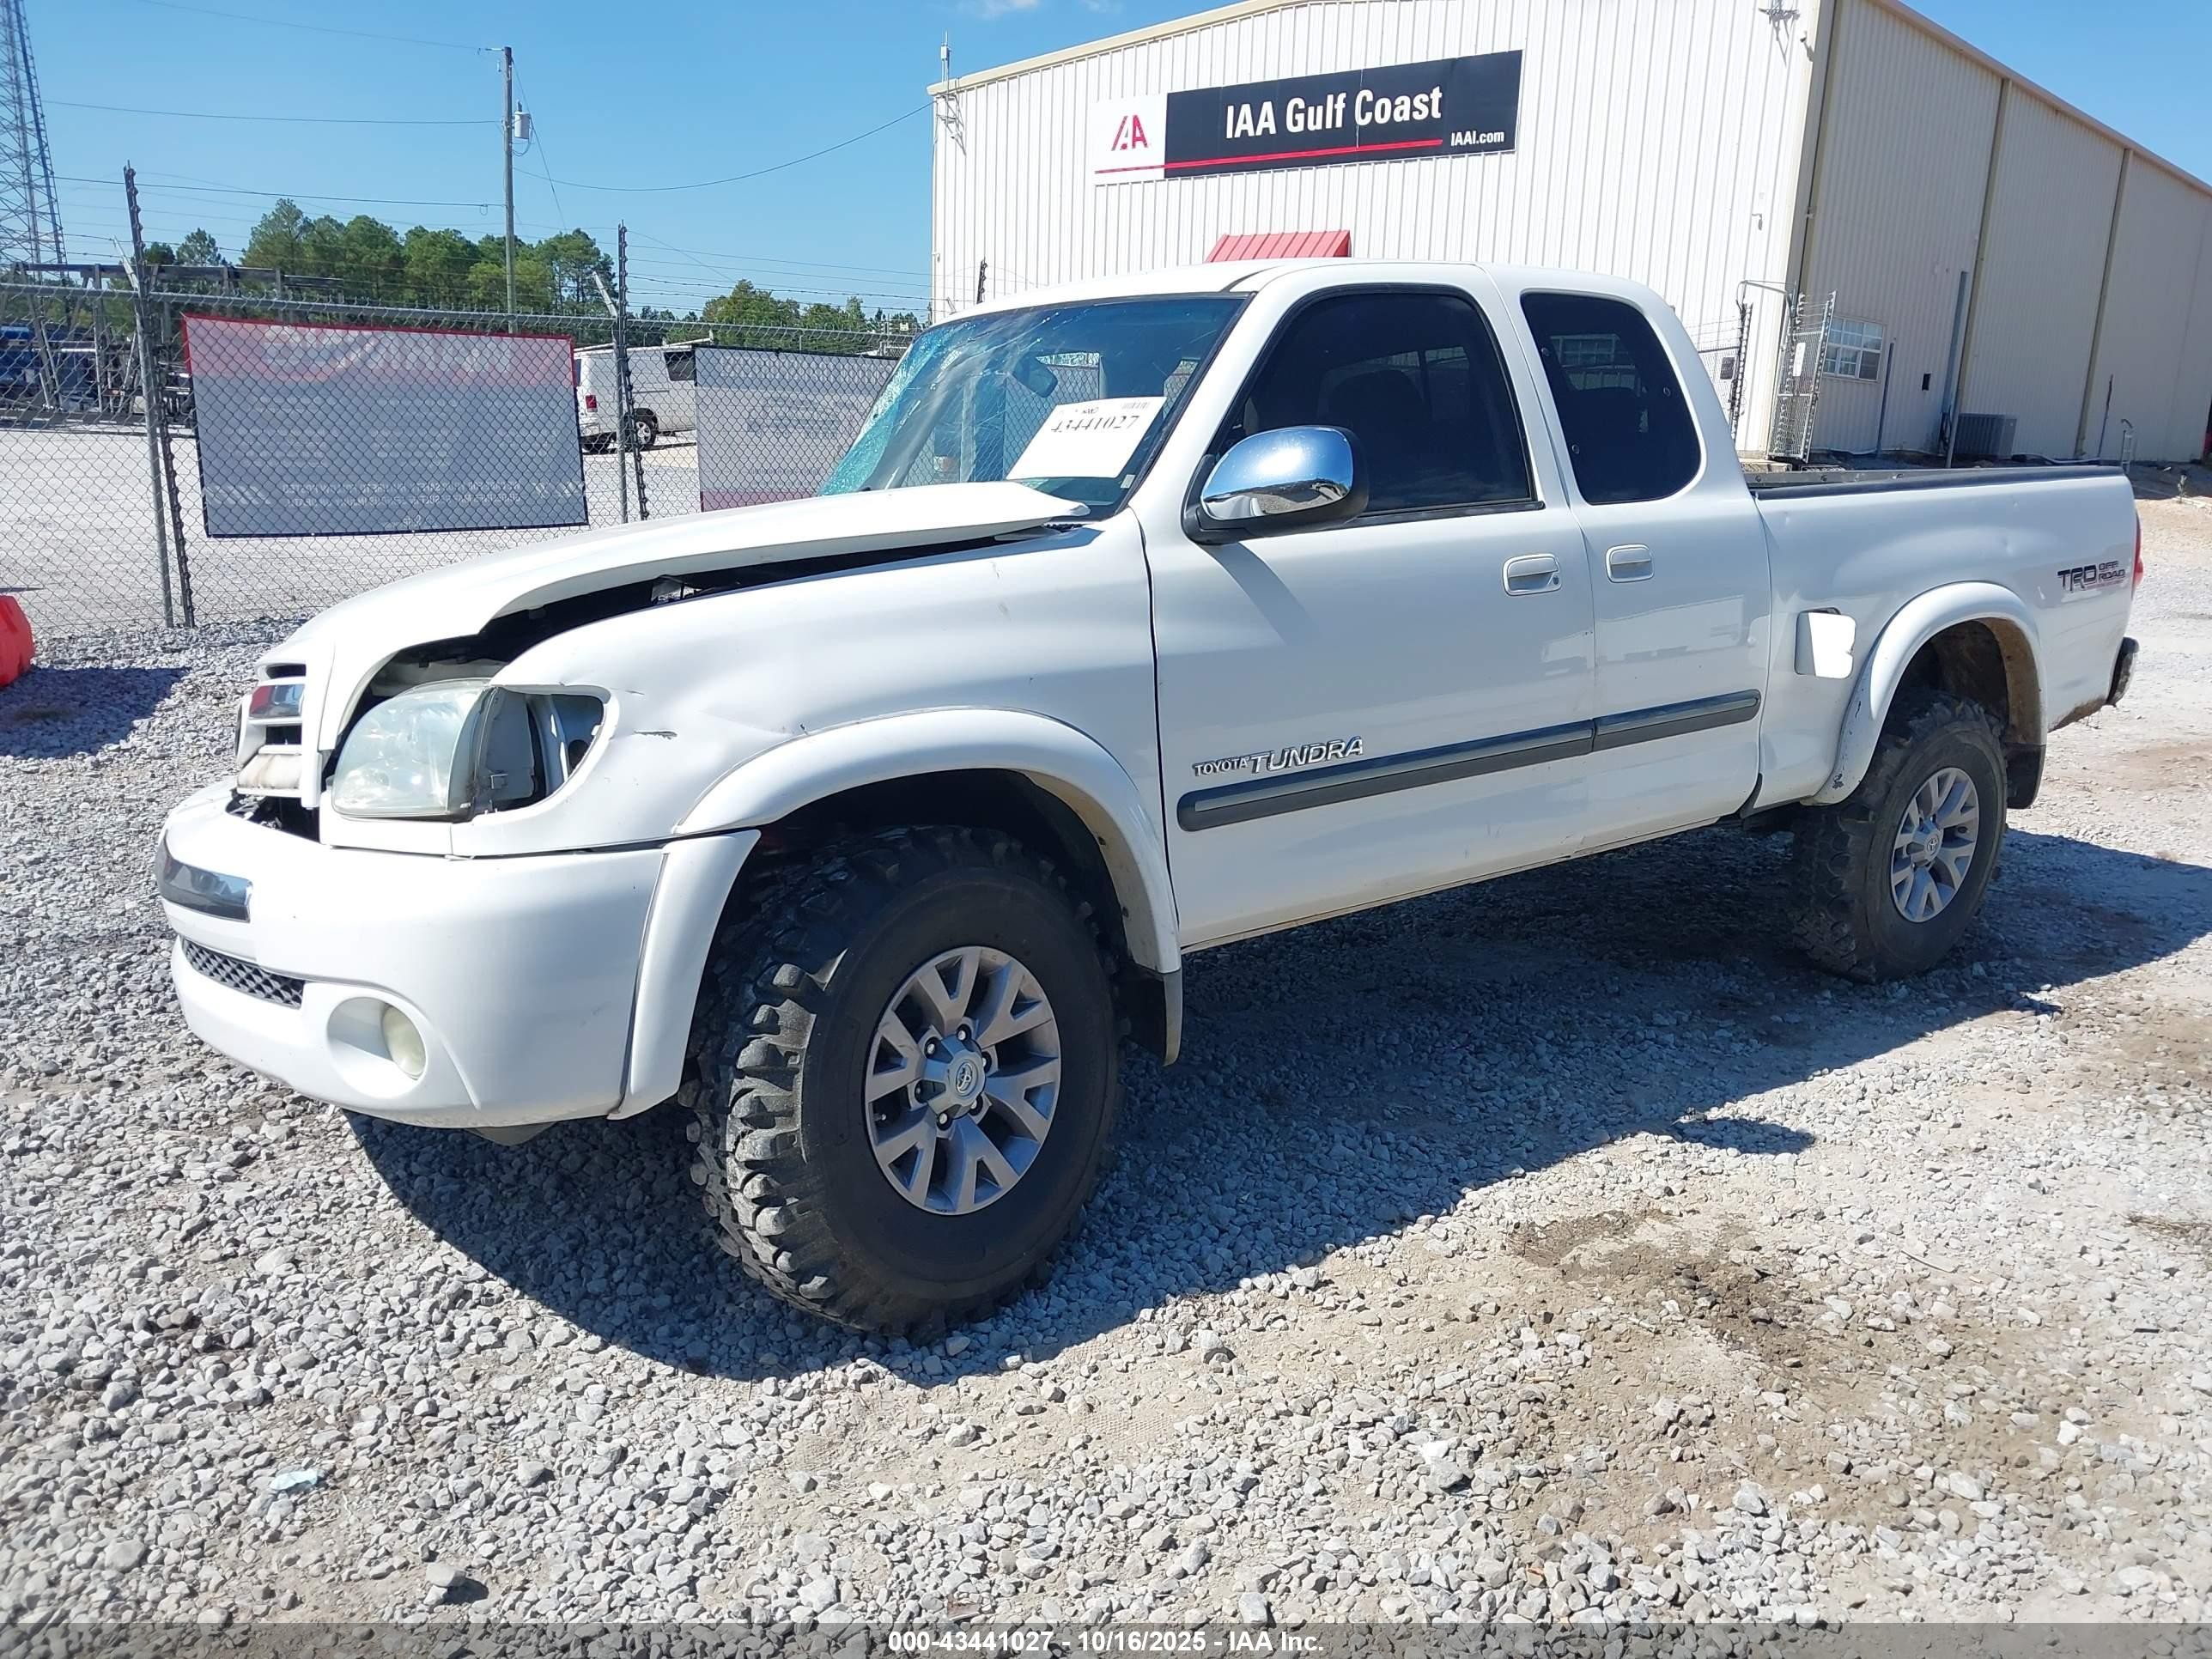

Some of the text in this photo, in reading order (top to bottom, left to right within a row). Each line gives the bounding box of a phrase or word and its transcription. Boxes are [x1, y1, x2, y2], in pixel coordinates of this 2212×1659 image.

[1225, 86, 1443, 138] IAA Gulf Coast
[1450, 130, 1504, 147] IAAI.com
[2057, 564, 2097, 592] TRD
[1194, 736, 1364, 777] TOYOTA TUNDRA
